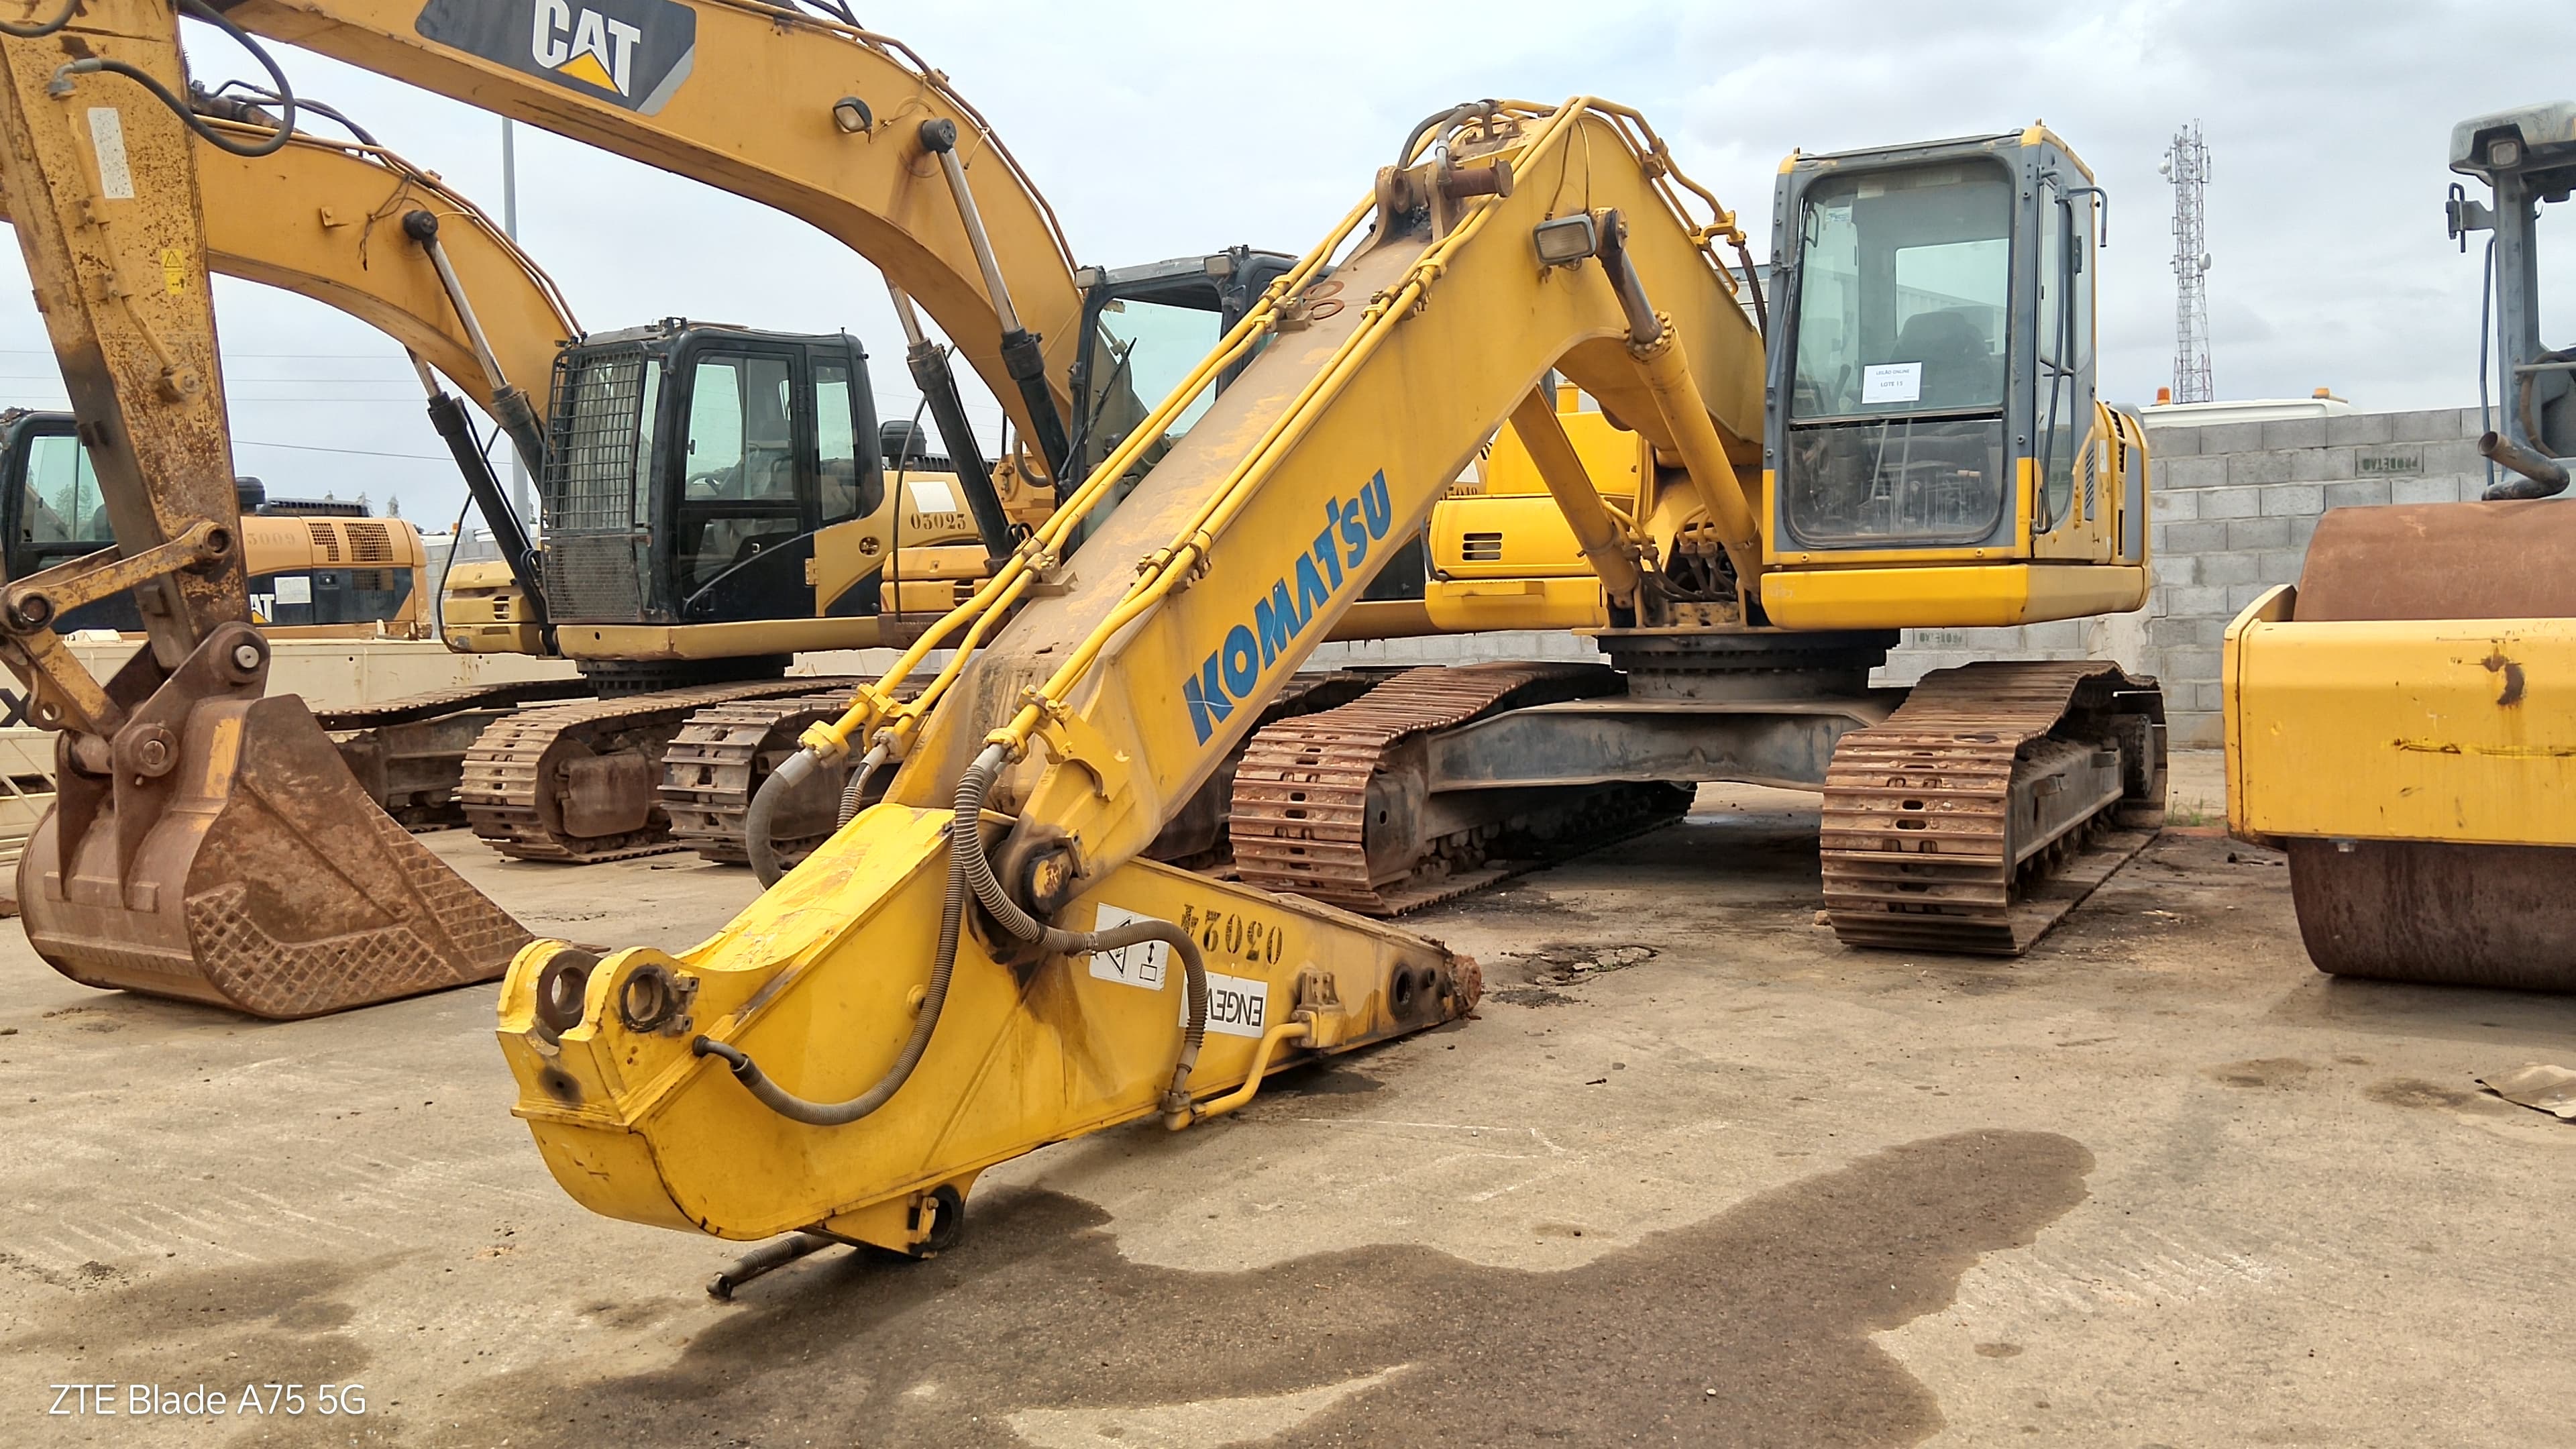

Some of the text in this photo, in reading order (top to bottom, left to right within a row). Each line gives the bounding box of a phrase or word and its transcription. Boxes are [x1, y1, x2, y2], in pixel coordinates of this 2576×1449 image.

[532, 0, 641, 97] CAT
[910, 513, 967, 530] 03023
[250, 594, 275, 623] AT
[1182, 467, 1391, 747] KOMATSU
[1181, 904, 1283, 965] 03024
